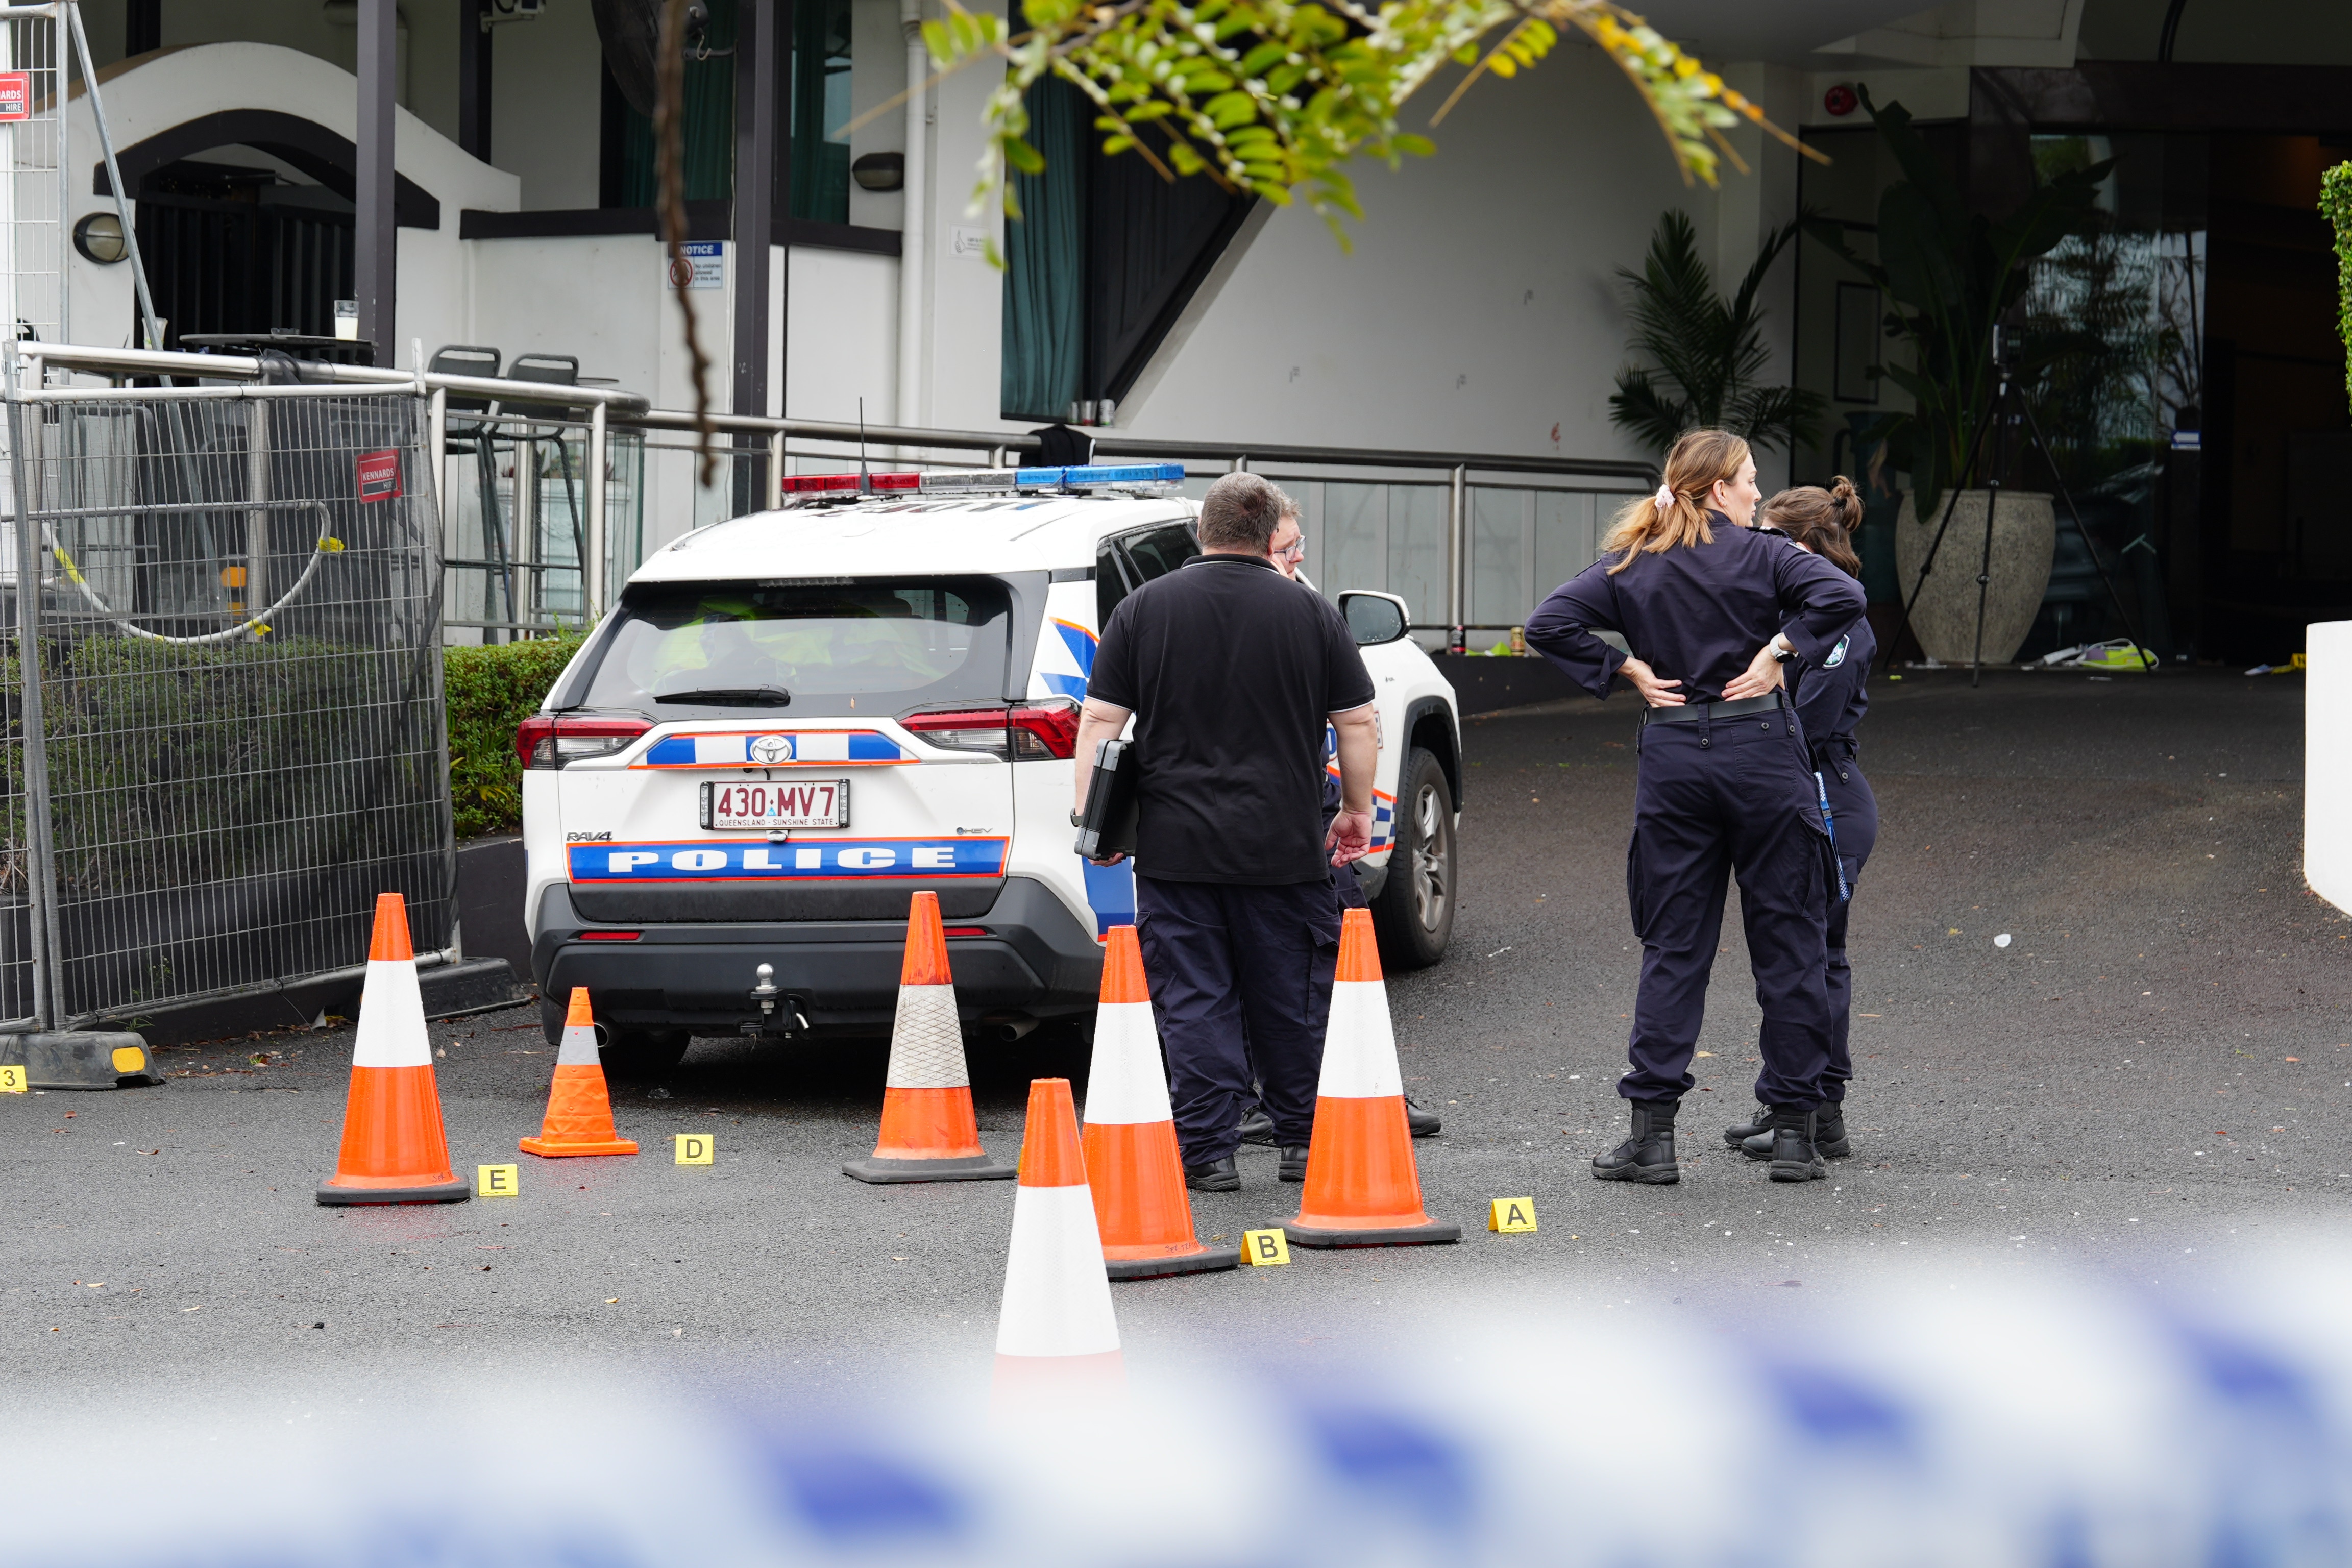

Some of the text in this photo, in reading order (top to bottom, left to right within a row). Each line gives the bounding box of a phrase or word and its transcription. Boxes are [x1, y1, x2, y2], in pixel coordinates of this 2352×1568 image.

[0, 90, 21, 100] ARDS
[6, 103, 21, 111] HIRE
[680, 244, 714, 255] NOTICE
[362, 468, 394, 481] KENNARDS
[718, 787, 834, 817] 430 MV7
[566, 831, 612, 842] RAV4
[608, 847, 956, 872] POLICE
[4, 1070, 15, 1086] 3
[685, 1139, 703, 1158] D
[489, 1169, 506, 1190] E
[1507, 1204, 1528, 1226] A
[1258, 1235, 1278, 1258] B
